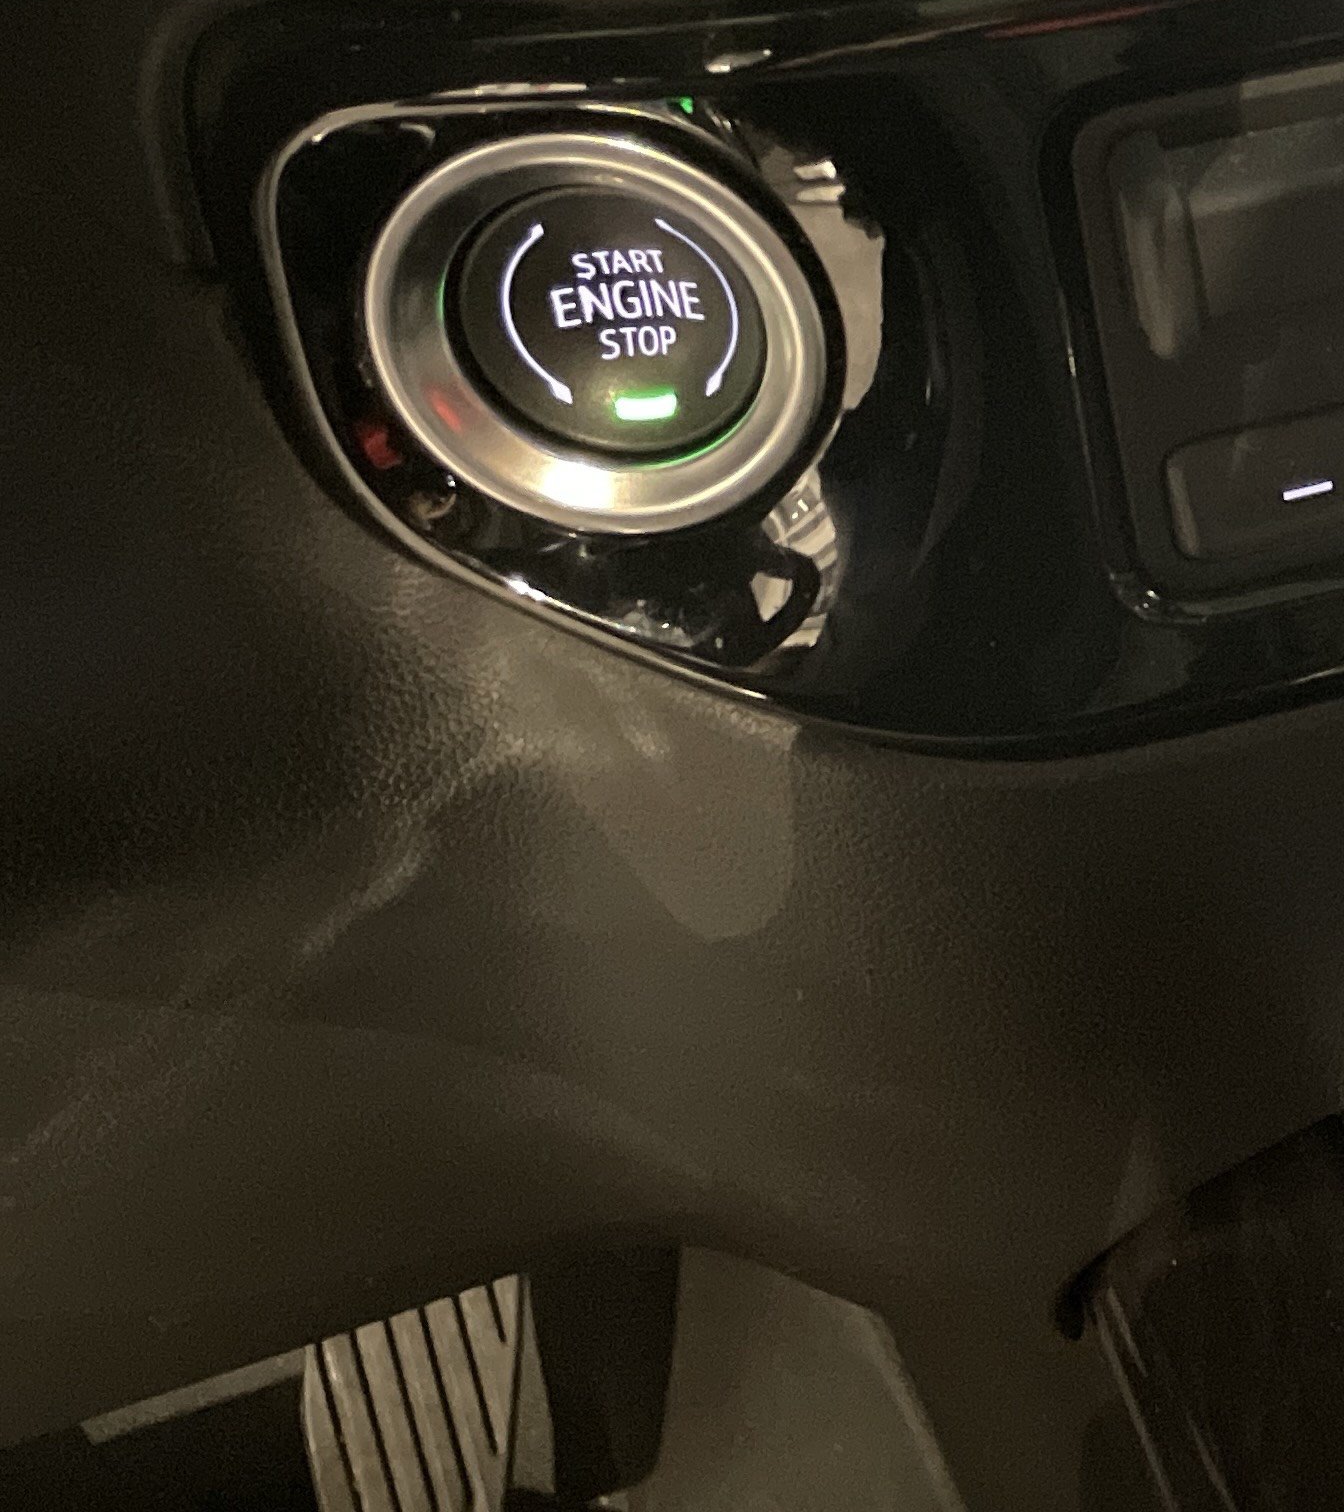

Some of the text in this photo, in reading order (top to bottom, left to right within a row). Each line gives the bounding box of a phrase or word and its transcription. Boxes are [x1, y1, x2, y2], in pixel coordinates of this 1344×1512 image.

[570, 248, 665, 280] START
[549, 278, 706, 331] ENGINE
[598, 324, 678, 361] STOP
